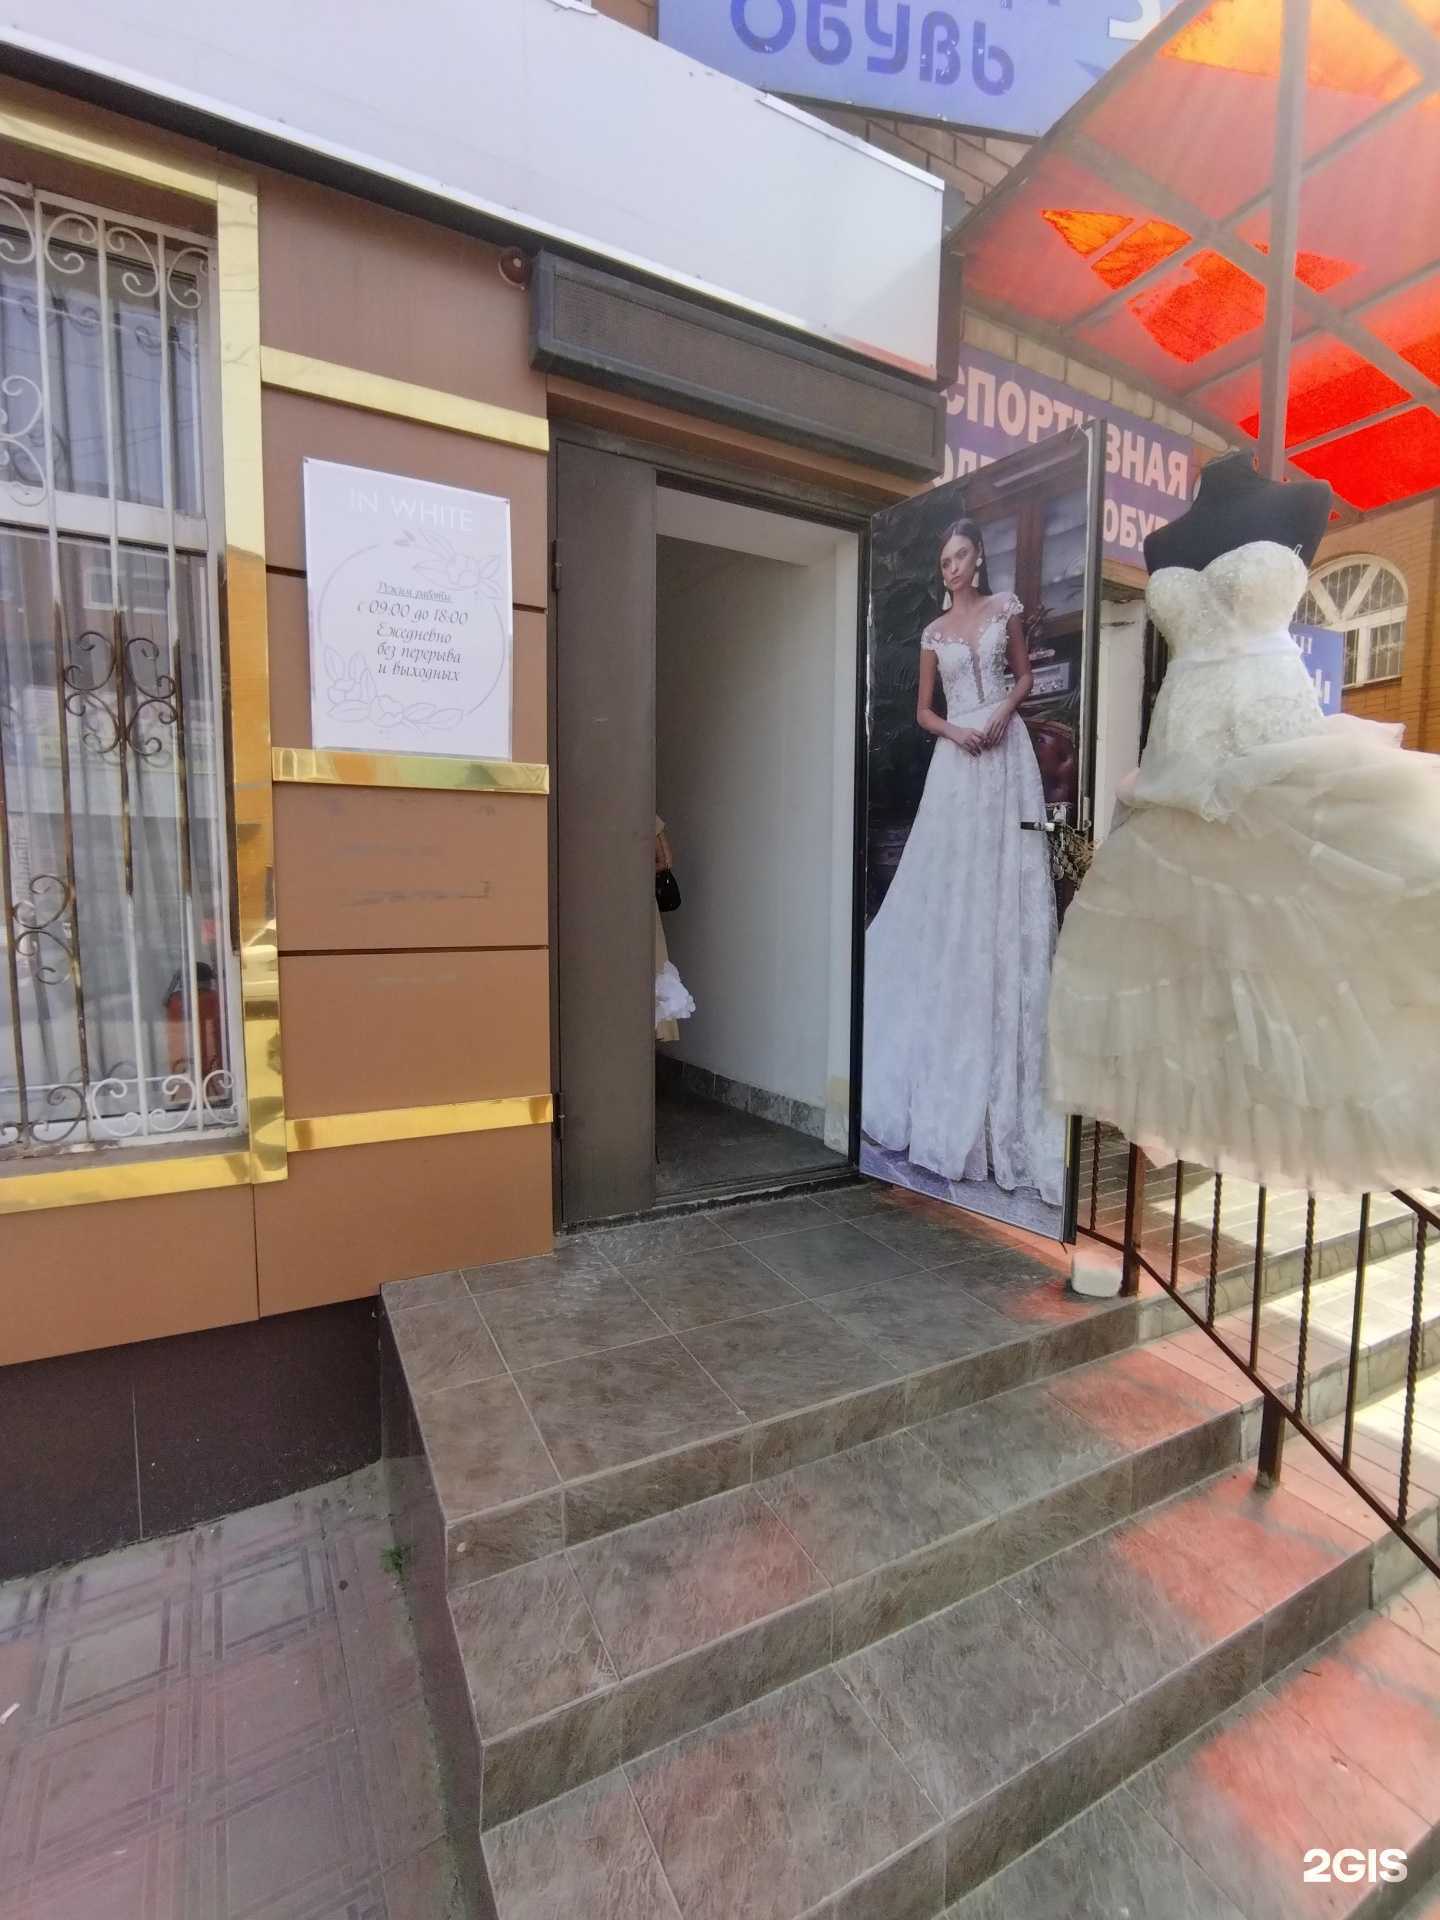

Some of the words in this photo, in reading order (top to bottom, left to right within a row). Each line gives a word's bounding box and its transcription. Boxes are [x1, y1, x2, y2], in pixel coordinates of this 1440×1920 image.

[350, 488, 378, 513] IN
[391, 496, 473, 531] WHITE
[1103, 498, 1168, 552] ОБУ
[411, 608, 429, 623] до
[376, 623, 453, 644] Ежедневно
[377, 641, 397, 661] без
[401, 647, 464, 665] перерыва
[378, 663, 388, 675] и
[392, 661, 461, 682] выходных
